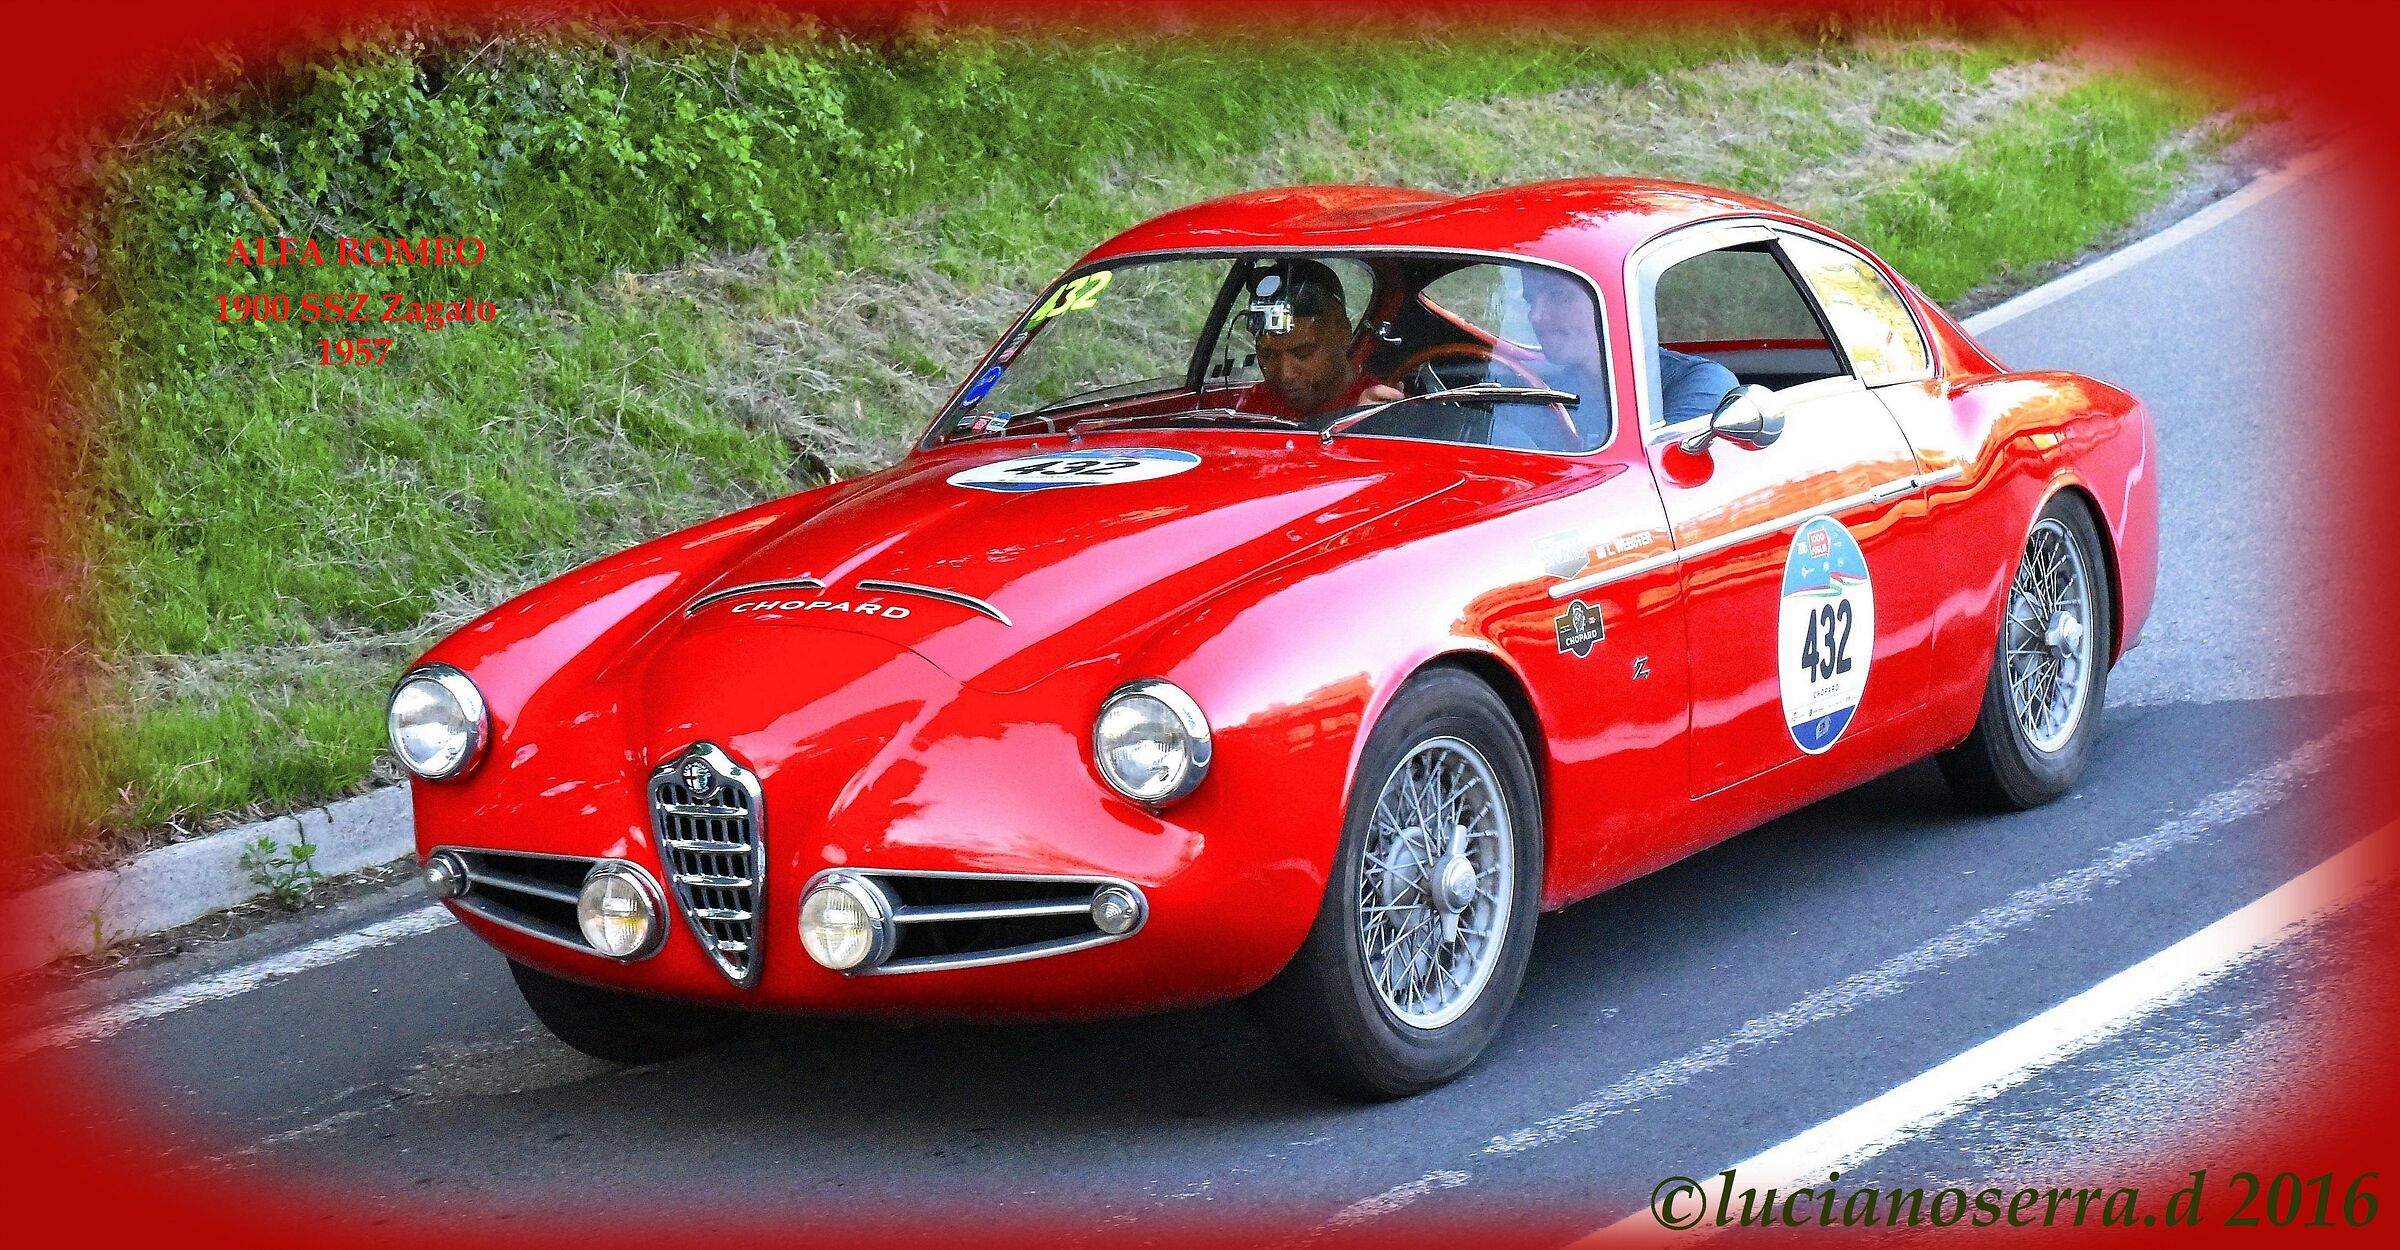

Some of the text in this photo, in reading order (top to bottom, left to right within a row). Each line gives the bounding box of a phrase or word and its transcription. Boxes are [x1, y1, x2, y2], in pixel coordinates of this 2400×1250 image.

[1027, 270, 1113, 331] 432
[1003, 460, 1141, 476] 432
[731, 600, 912, 619] CHOPARD
[1565, 629, 1598, 647] CHOPARD
[1801, 598, 1853, 684] 432
[1813, 684, 1840, 699] CHOPARD
